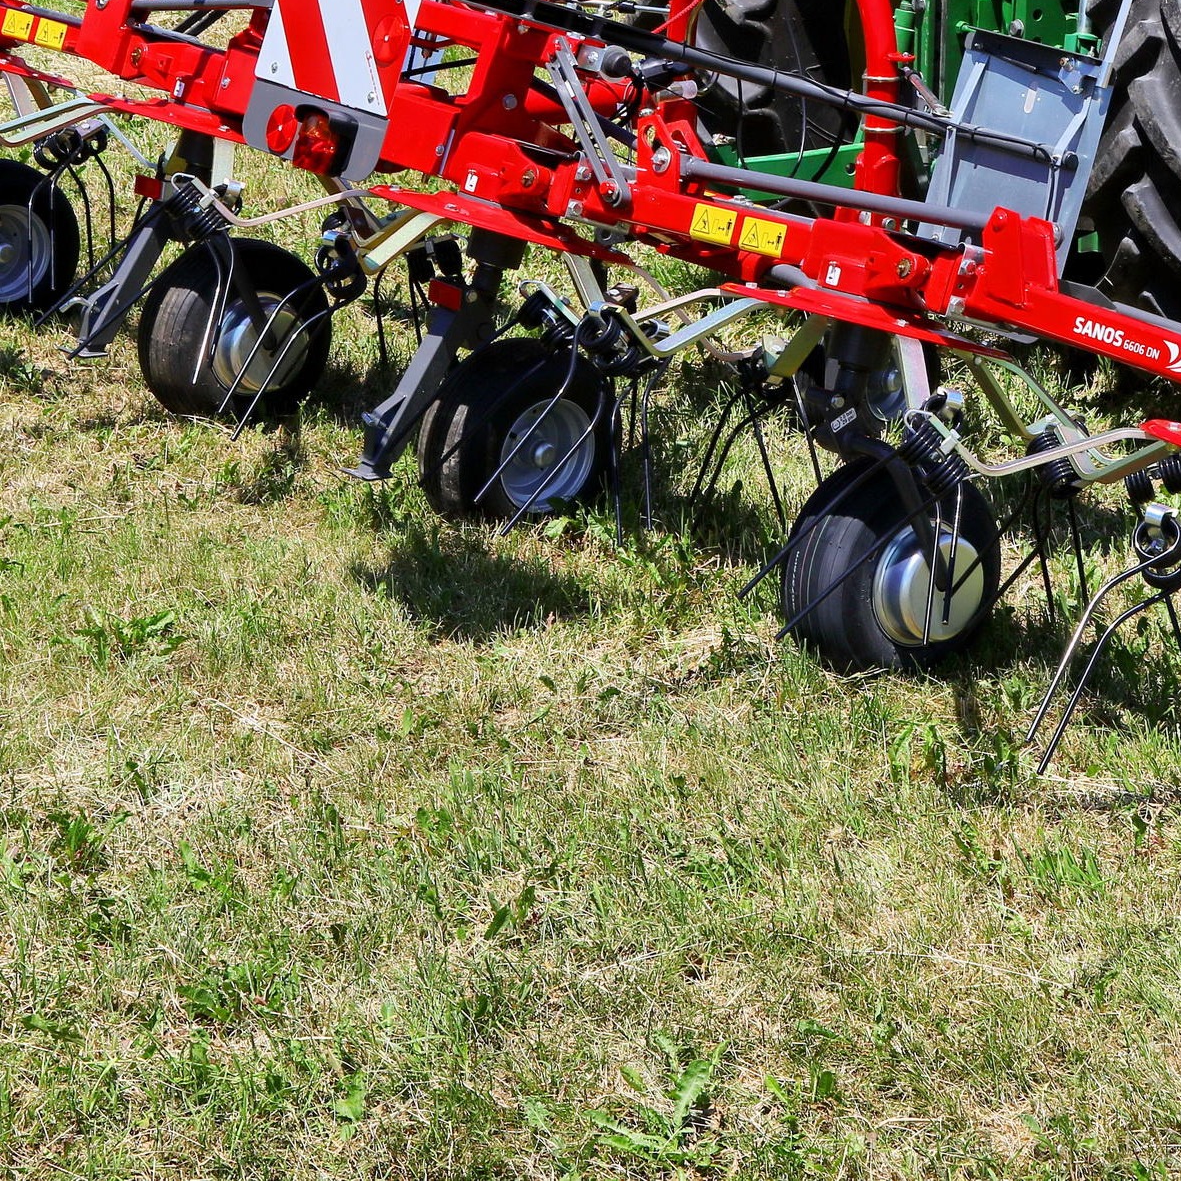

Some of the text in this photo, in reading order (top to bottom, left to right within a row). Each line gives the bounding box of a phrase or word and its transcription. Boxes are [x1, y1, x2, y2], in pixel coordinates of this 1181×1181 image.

[1073, 316, 1161, 360] SANOS 6606 DN
